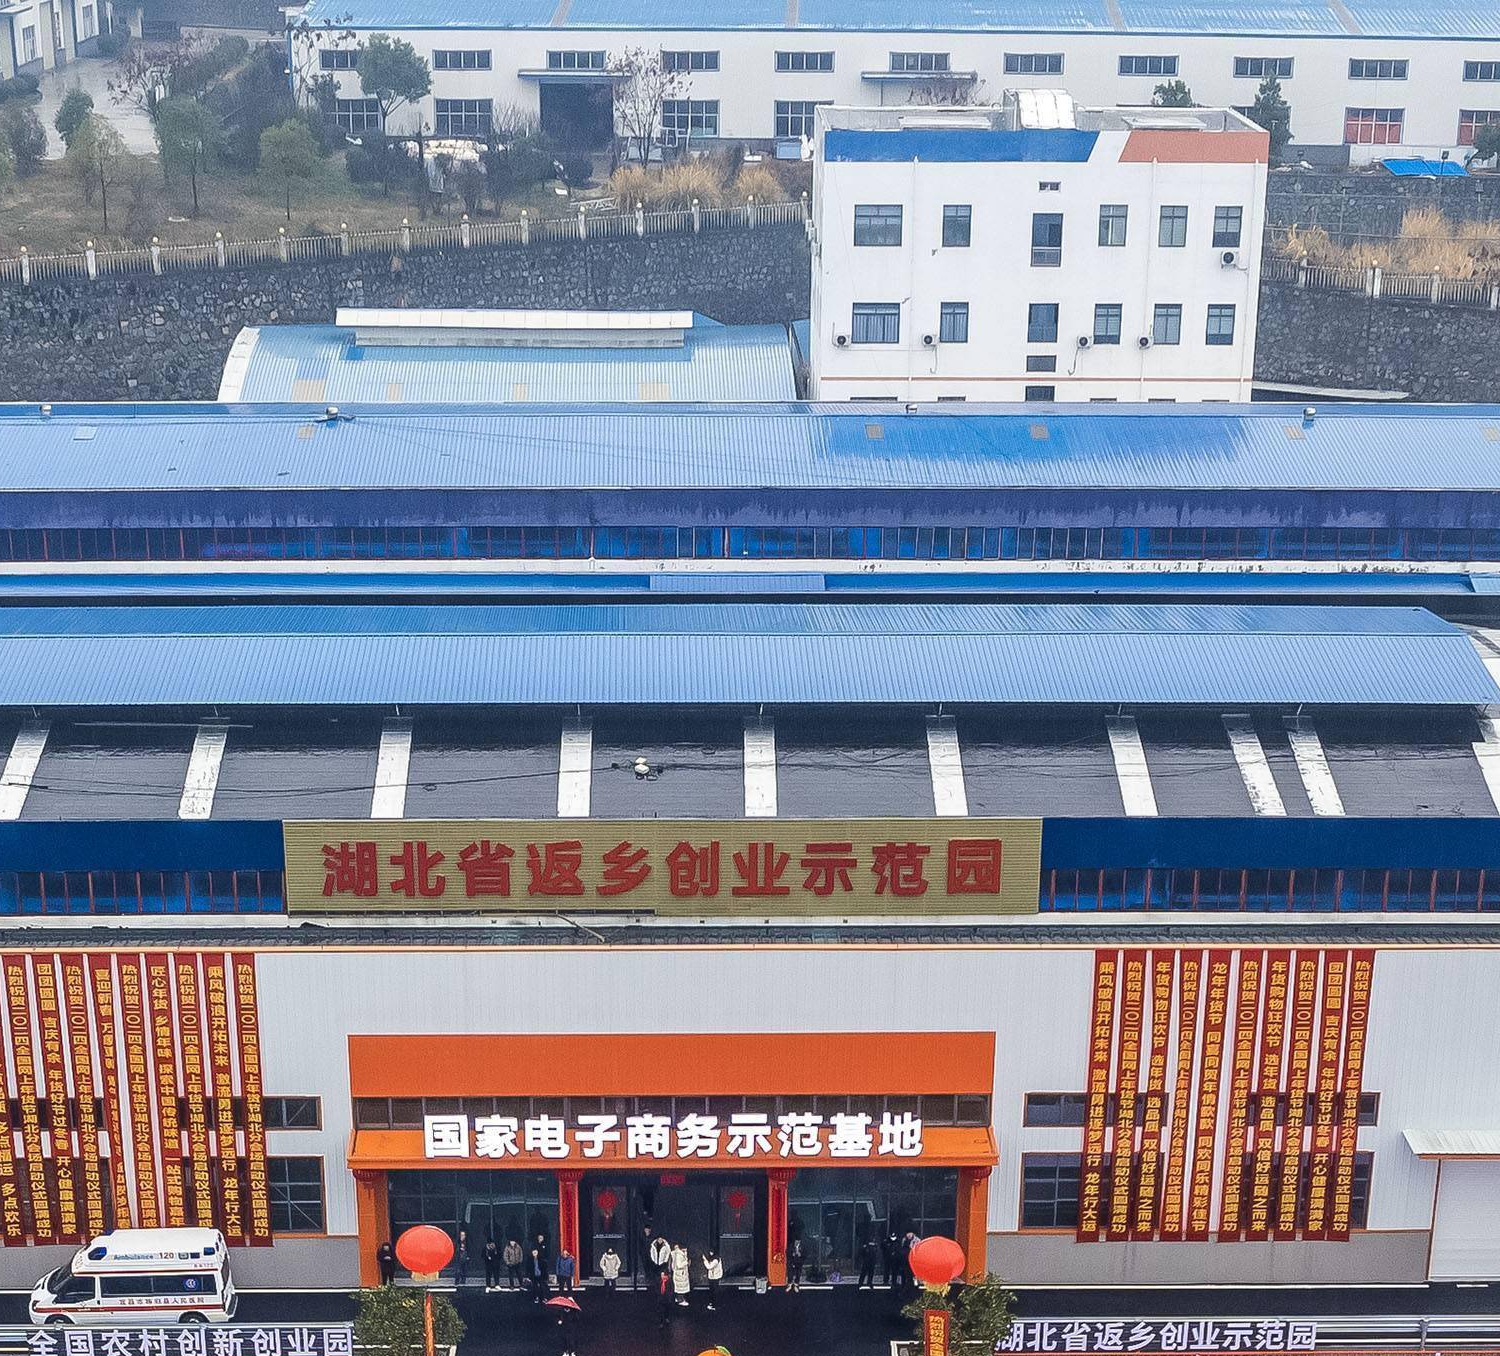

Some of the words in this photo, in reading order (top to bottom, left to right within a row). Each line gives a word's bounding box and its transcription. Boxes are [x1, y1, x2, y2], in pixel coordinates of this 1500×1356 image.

[321, 838, 1004, 899] 湖北省返乡创业示范园
[122, 965, 157, 1227] 热烈祝贺二〇二四全国网上年货节湖北分会场启动仪式圆满成
[179, 965, 211, 1226] 热烈祝贺二〇二四全国网上年货节湖北分会场启动仪式圆满成
[422, 1112, 925, 1160] 国家电子商务示范基地
[166, 1158, 184, 1225] 一站式购物嘉年
[159, 1252, 174, 1260] 120
[997, 1320, 1318, 1352] 湖北省返乡创业示范园
